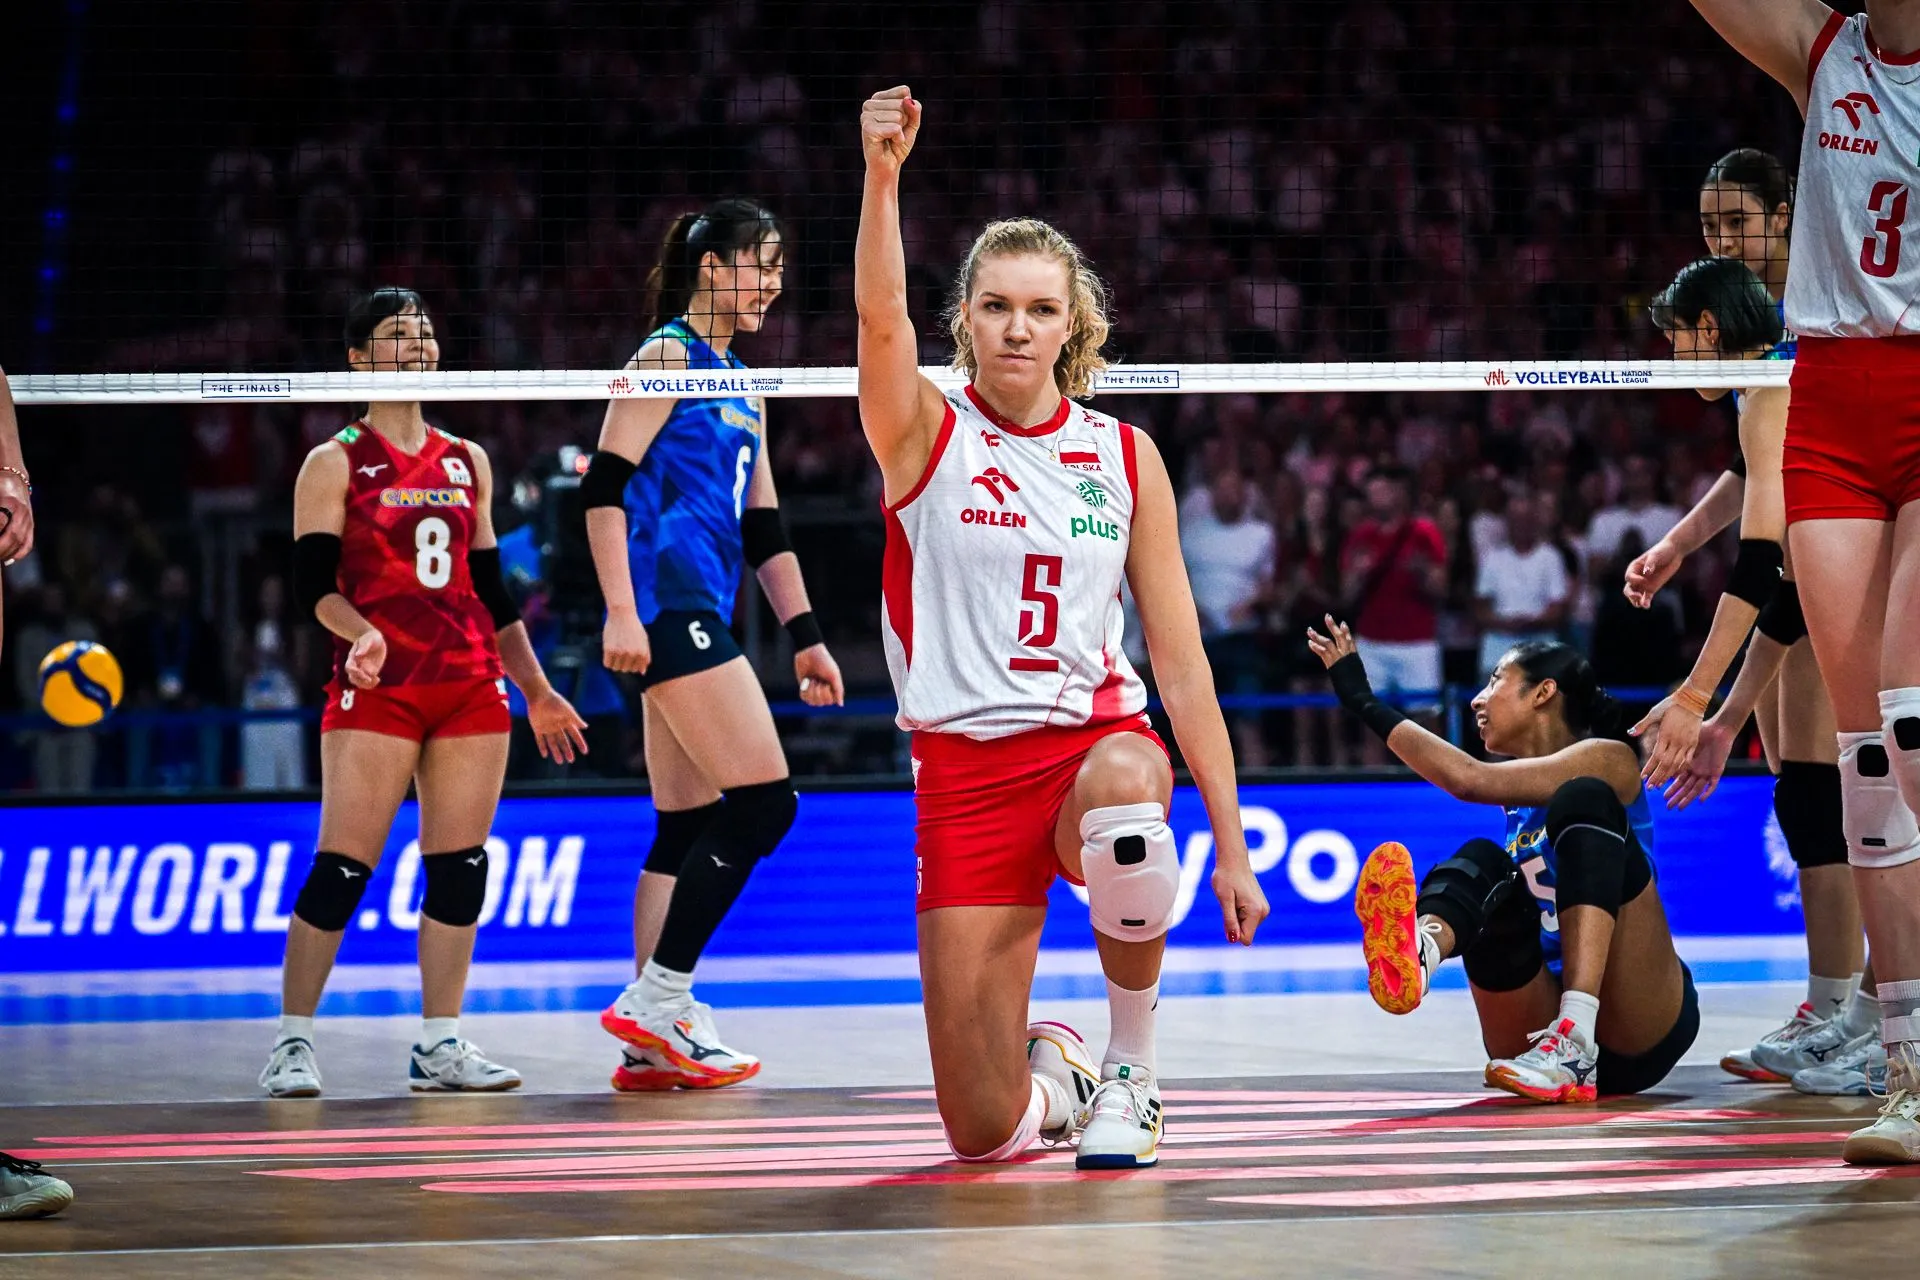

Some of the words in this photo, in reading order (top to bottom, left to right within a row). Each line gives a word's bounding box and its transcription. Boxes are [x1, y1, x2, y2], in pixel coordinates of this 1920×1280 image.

[1818, 132, 1878, 156] ORLEN
[1860, 181, 1909, 278] 3
[212, 384, 233, 392] THE
[239, 384, 280, 393] FINALS
[640, 379, 748, 392] VOLLEYBALL
[1515, 371, 1619, 384] VOLLEYBALL
[960, 508, 1027, 528] ORLEN
[1070, 514, 1119, 541] plus
[415, 517, 452, 589] 8
[1017, 553, 1063, 648] 5
[688, 620, 711, 650] 6
[0, 835, 586, 936] LWORL.CM
[1520, 856, 1560, 932] 5
